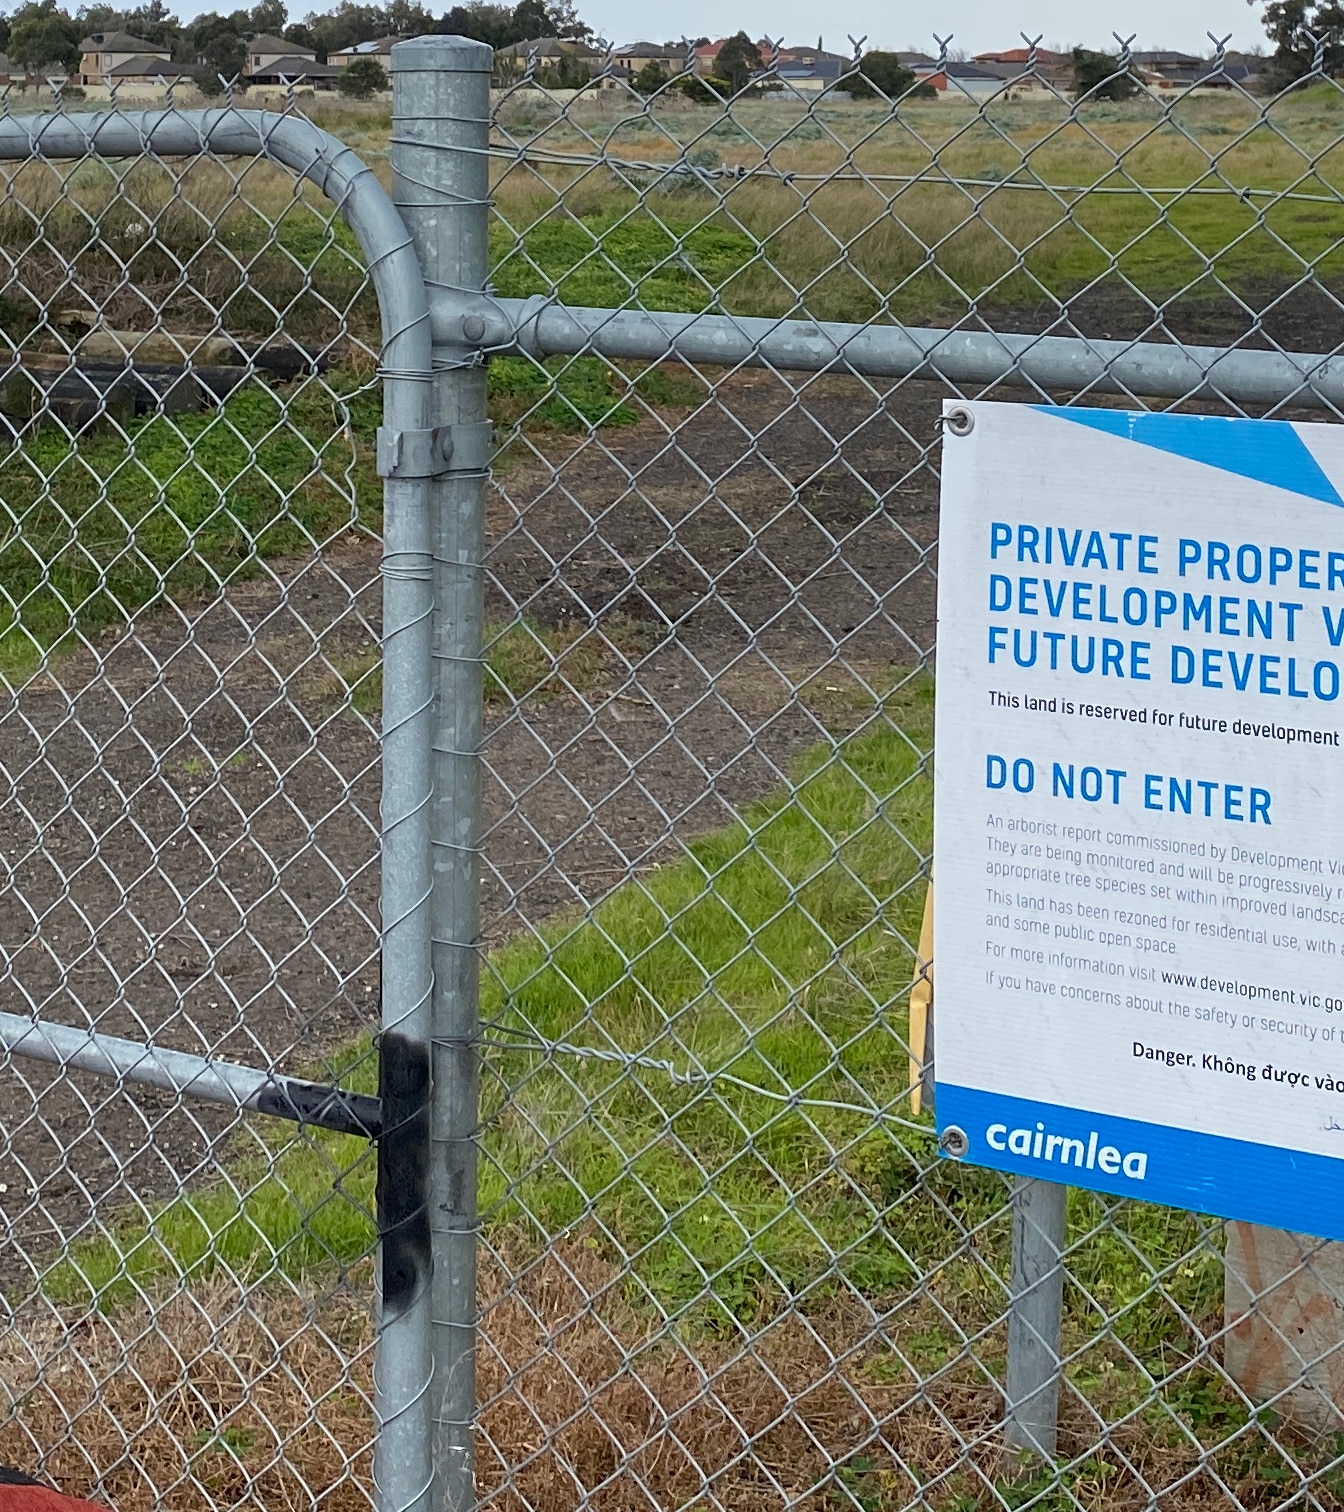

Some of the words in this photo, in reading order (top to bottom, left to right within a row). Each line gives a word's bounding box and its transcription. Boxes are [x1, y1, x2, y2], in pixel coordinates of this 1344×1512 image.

[990, 521, 1159, 574] PRIVATE
[988, 573, 1304, 642] DEVELOPMENT
[988, 625, 1151, 681] FUTURE
[987, 690, 1020, 709] This
[1024, 693, 1057, 713] land
[1061, 697, 1074, 715] is
[1079, 703, 1147, 723] reserved
[1152, 708, 1175, 727] for
[1179, 711, 1228, 733] future
[1232, 718, 1340, 747] development
[985, 753, 1035, 794] DO
[1052, 761, 1127, 805] NOT
[1143, 773, 1272, 826] ENTER
[985, 813, 1003, 829] An
[1007, 817, 1058, 837] arborist
[1062, 826, 1102, 843] report
[1105, 831, 1206, 857] commissioned
[1210, 842, 1227, 863] by
[1230, 846, 1324, 876] Development
[986, 835, 1017, 857] They
[1020, 843, 1042, 858] are
[1045, 843, 1082, 866] being
[1086, 852, 1155, 874] monitored
[1158, 862, 1184, 878] and
[1188, 865, 1213, 882] will
[1217, 867, 1234, 885] be
[1238, 874, 1333, 902] progressively
[985, 861, 1061, 884] appropriate
[1064, 871, 1091, 888] tree
[1094, 876, 1146, 896] species
[1150, 884, 1172, 900] set
[1175, 888, 1217, 906] within
[1221, 895, 1287, 917] improved
[985, 887, 1013, 906] This
[1016, 892, 1045, 911] land
[1049, 897, 1073, 915] has
[1077, 901, 1110, 920] been
[1113, 909, 1167, 930] rezoned
[1171, 915, 1191, 932] for
[1195, 921, 1267, 945] residential
[1272, 933, 1301, 953] use,
[1305, 938, 1336, 955] with
[985, 913, 1010, 929] and
[1013, 918, 1050, 935] some
[1054, 923, 1095, 942] public
[1098, 931, 1131, 948] open
[985, 940, 1006, 957] For
[1009, 946, 1044, 964] more
[1048, 951, 1125, 977] information
[1128, 964, 1157, 982] visit
[985, 970, 994, 985] If
[997, 974, 1021, 990] you
[1025, 976, 1056, 996] have
[1060, 984, 1121, 1006] concerns
[1124, 994, 1164, 1014] about
[1168, 1000, 1191, 1018] the
[1194, 1006, 1238, 1029] safety
[1241, 1014, 1256, 1030] or
[1259, 1017, 1318, 1042] security
[1321, 1025, 1336, 1042] of
[1132, 1041, 1196, 1068] Danger.
[1202, 1052, 1256, 1081] Không
[1261, 1063, 1310, 1089] được
[986, 1122, 1147, 1179] cairnlea
